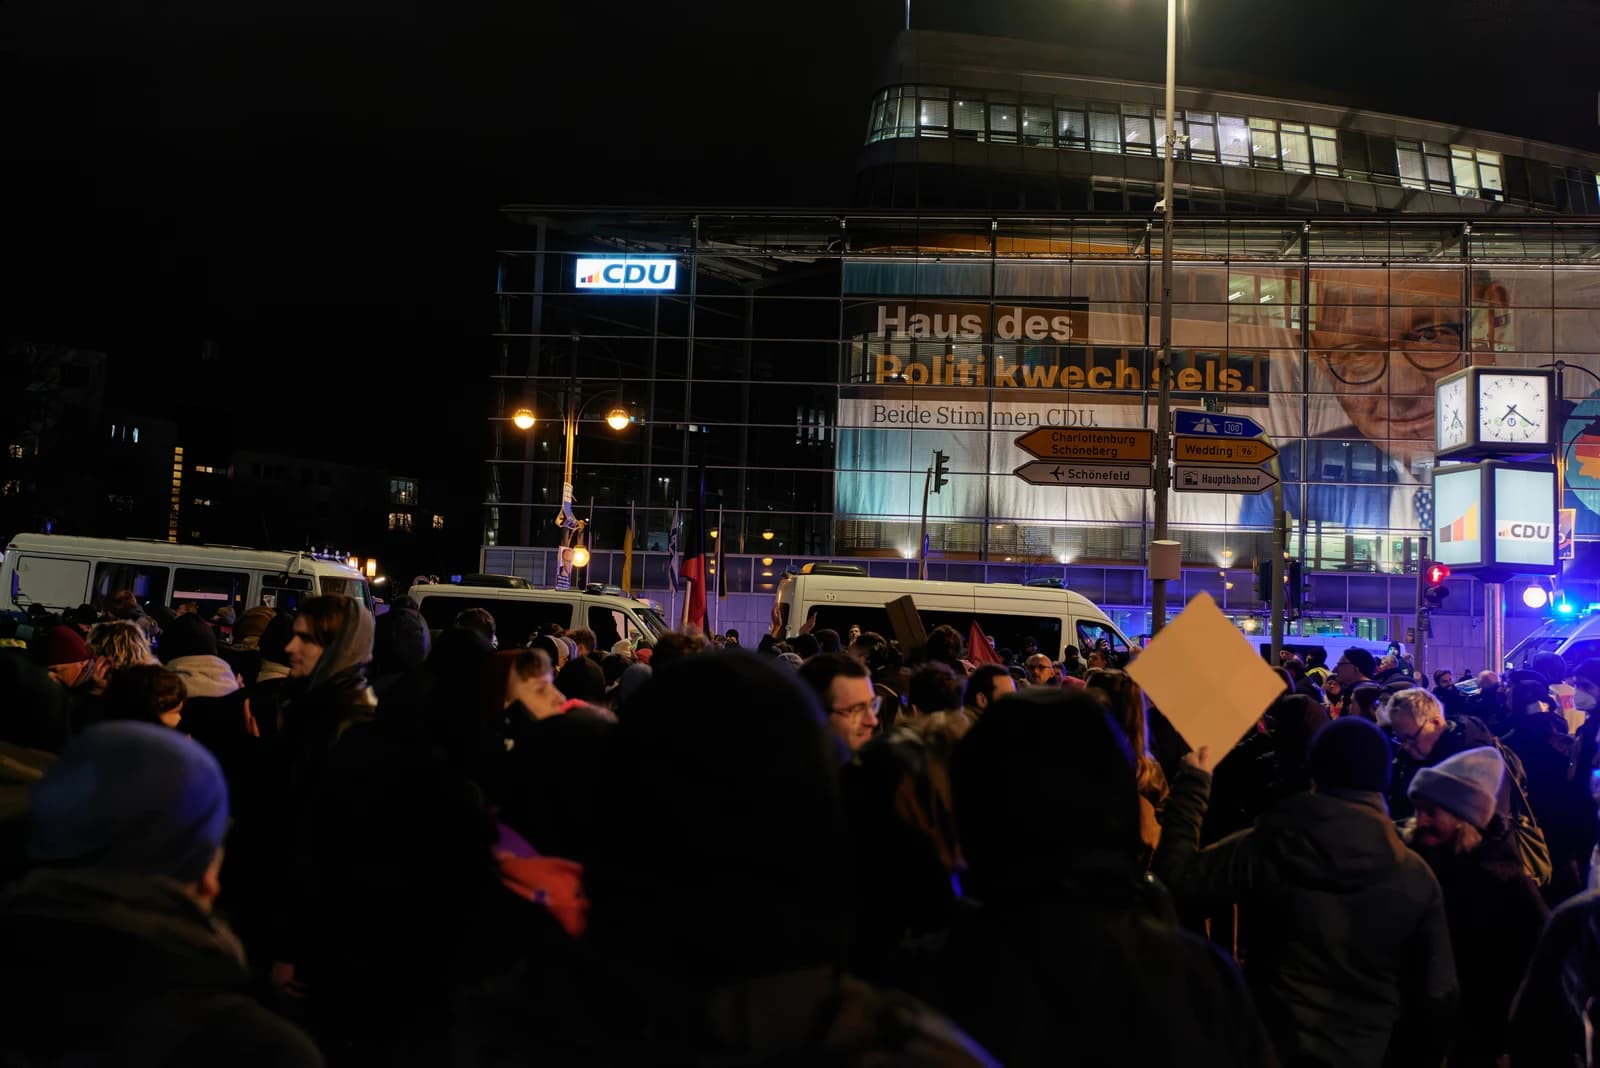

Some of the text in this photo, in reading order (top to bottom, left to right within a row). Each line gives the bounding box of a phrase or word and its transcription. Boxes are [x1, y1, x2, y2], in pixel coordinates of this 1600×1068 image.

[603, 263, 672, 285] CDU
[876, 305, 1074, 341] Haus des
[872, 405, 931, 425] Beide
[1046, 409, 1099, 429] CDU.
[1226, 424, 1240, 433] 100
[1051, 430, 1136, 447] Charlottenburg
[1051, 444, 1118, 458] Schöneberg
[1185, 444, 1253, 458] Wedding 96
[1067, 468, 1130, 481] Schönefeld
[1201, 473, 1261, 486] Hauptbahnhof
[1510, 523, 1550, 540] CDU
